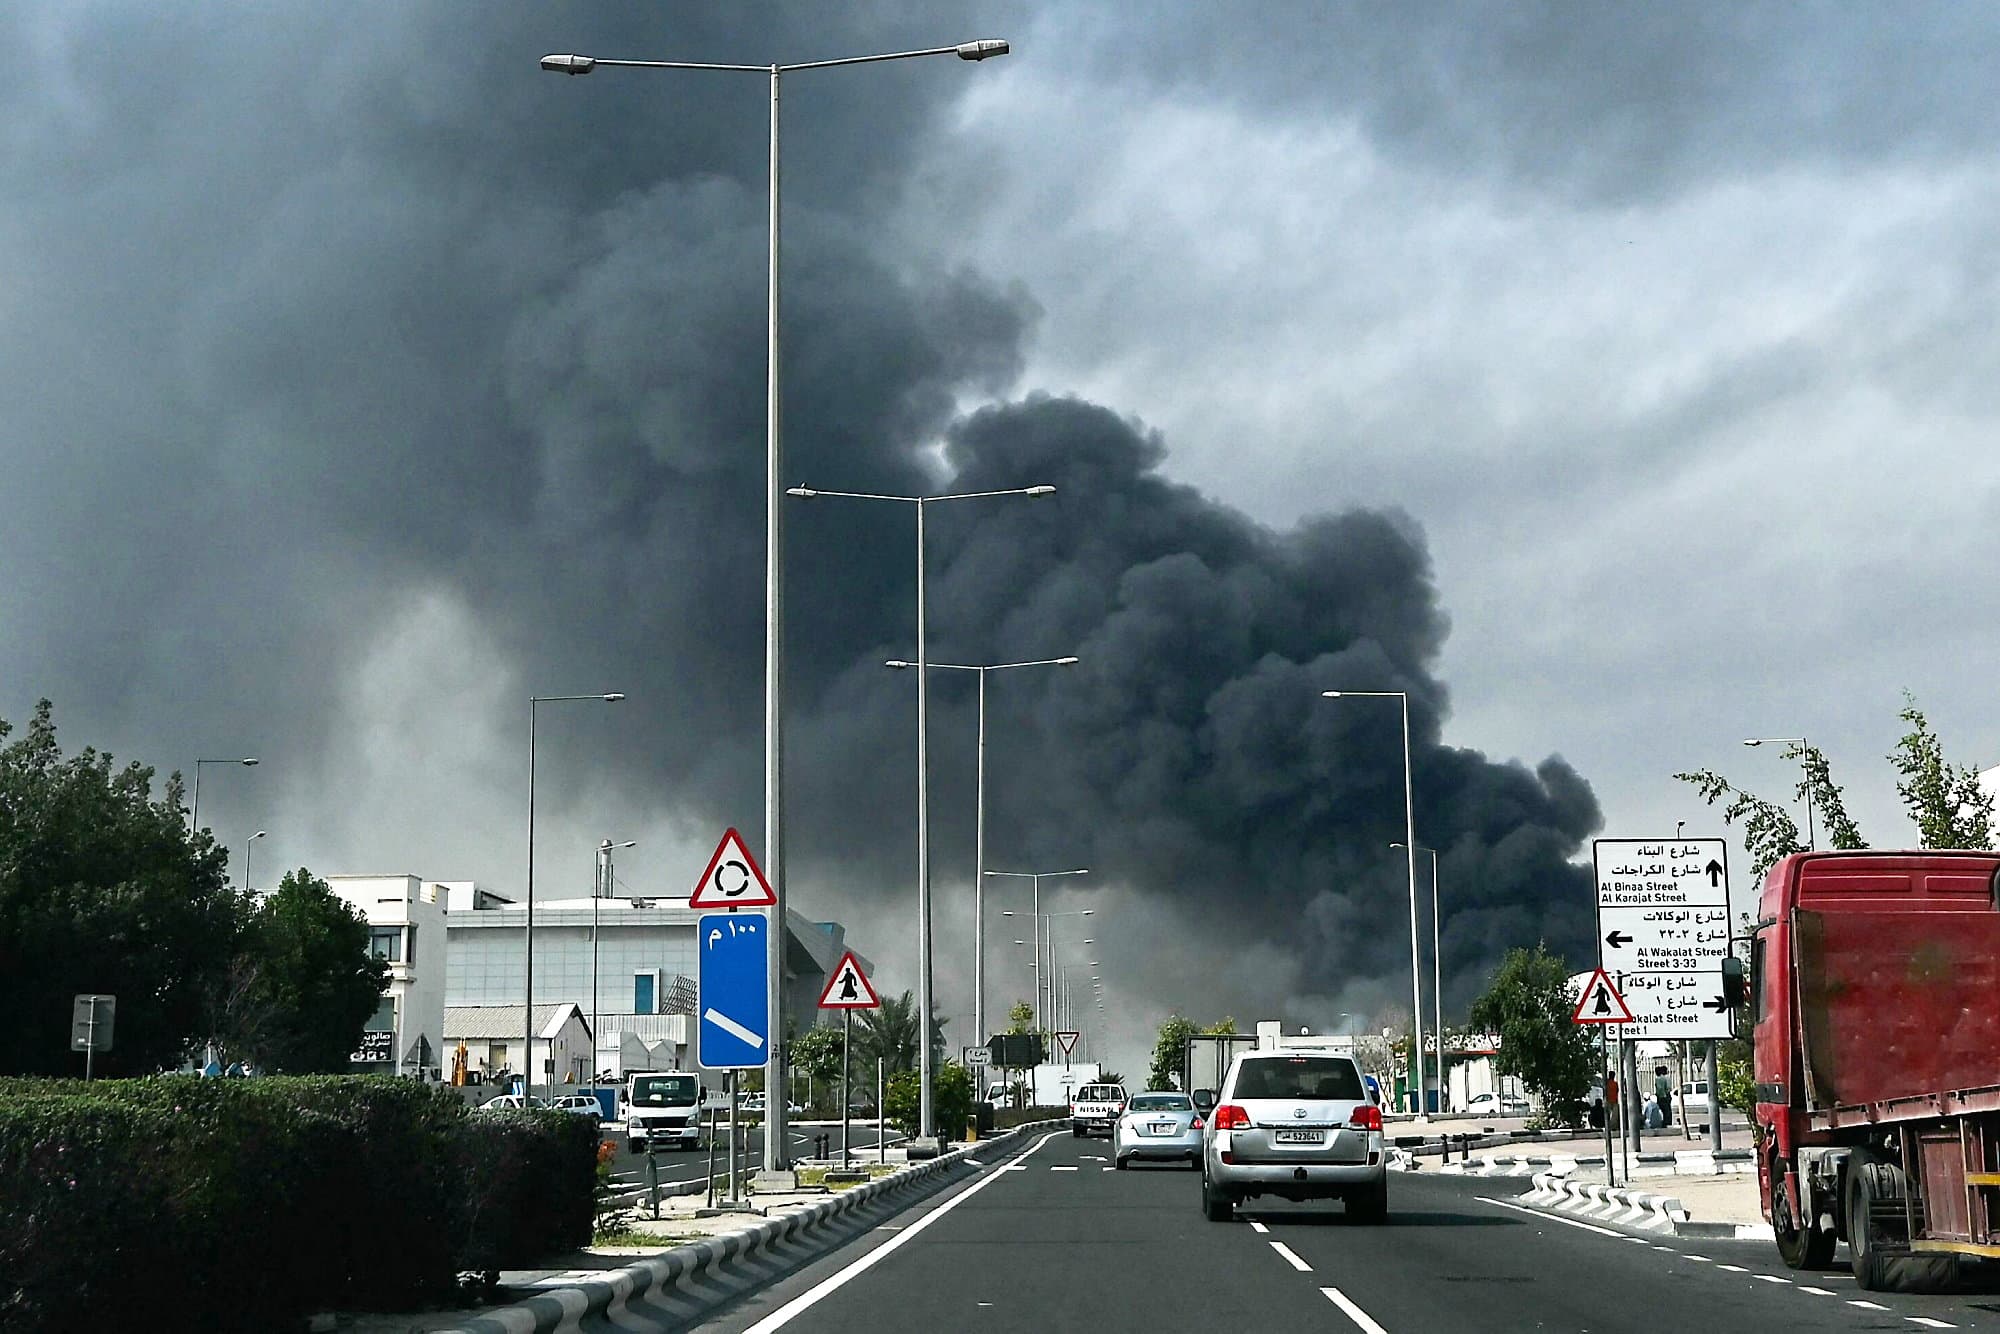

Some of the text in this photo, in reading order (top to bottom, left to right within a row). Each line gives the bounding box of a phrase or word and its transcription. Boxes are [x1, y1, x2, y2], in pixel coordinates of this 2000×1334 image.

[1638, 846, 1700, 858] شارع البناء
[1612, 865, 1701, 877] شارع الكراجات
[1601, 882, 1678, 891] Al Binaa Street
[1602, 893, 1687, 904] Al Karajat Street
[1643, 911, 1726, 924] شارع الوكالات
[709, 920, 756, 950] ١٠٠ م
[1697, 929, 1727, 942] شارع
[1637, 947, 1727, 957] Al Wakalat Street
[1638, 958, 1697, 968] Street 3-33
[1666, 977, 1697, 990] شارع
[1668, 996, 1698, 1009] شارع
[1666, 1014, 1699, 1023] Street
[1643, 1025, 1648, 1035] 1
